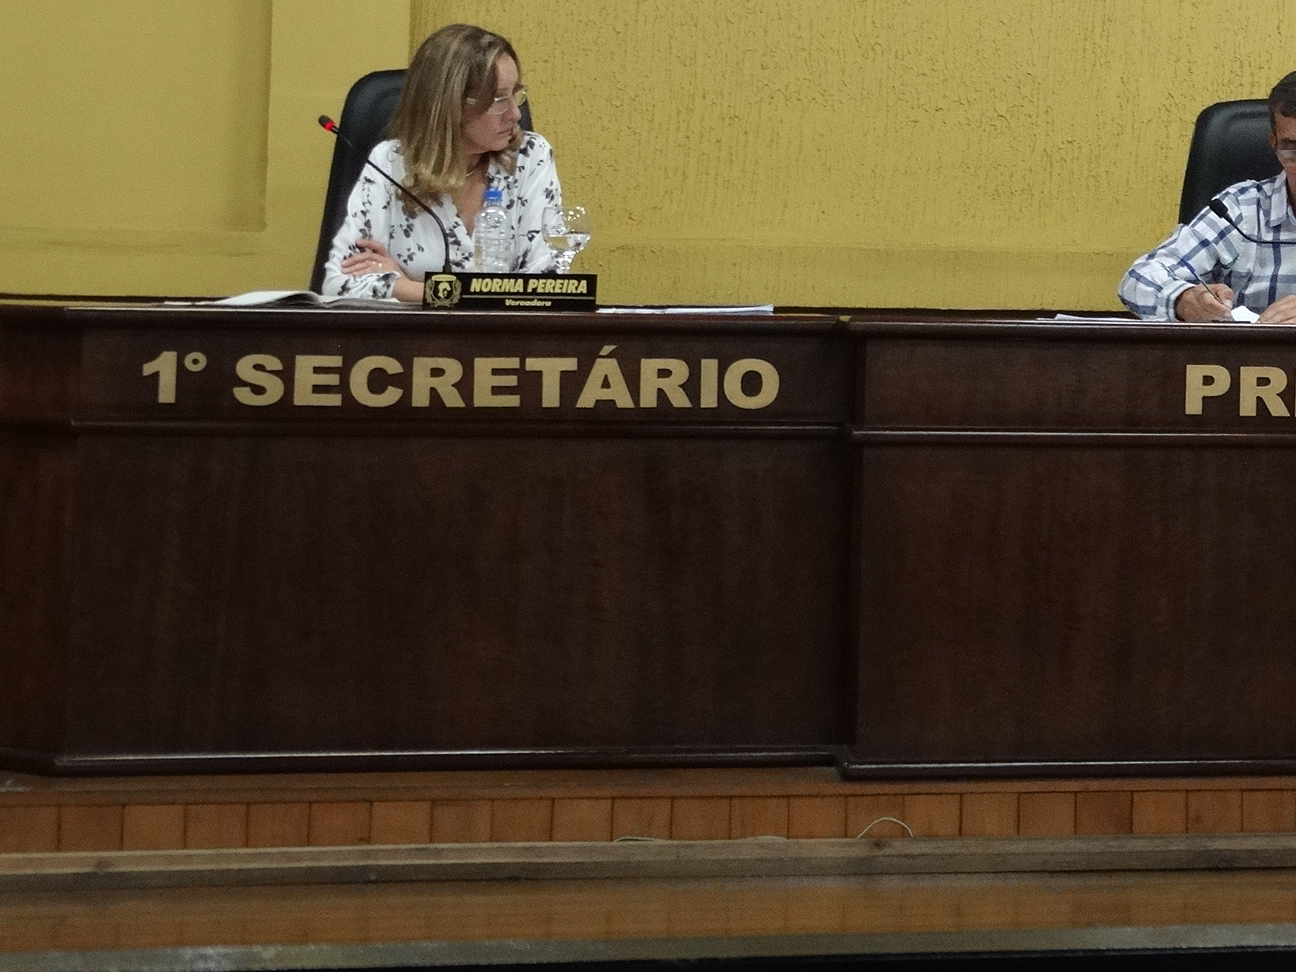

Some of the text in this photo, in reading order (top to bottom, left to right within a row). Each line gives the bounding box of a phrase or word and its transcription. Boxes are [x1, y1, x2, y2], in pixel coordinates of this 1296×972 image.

[470, 277, 588, 294] NORMA PEREIRA
[504, 298, 552, 307] Vereadora
[232, 344, 781, 410] SECRETÁRIO
